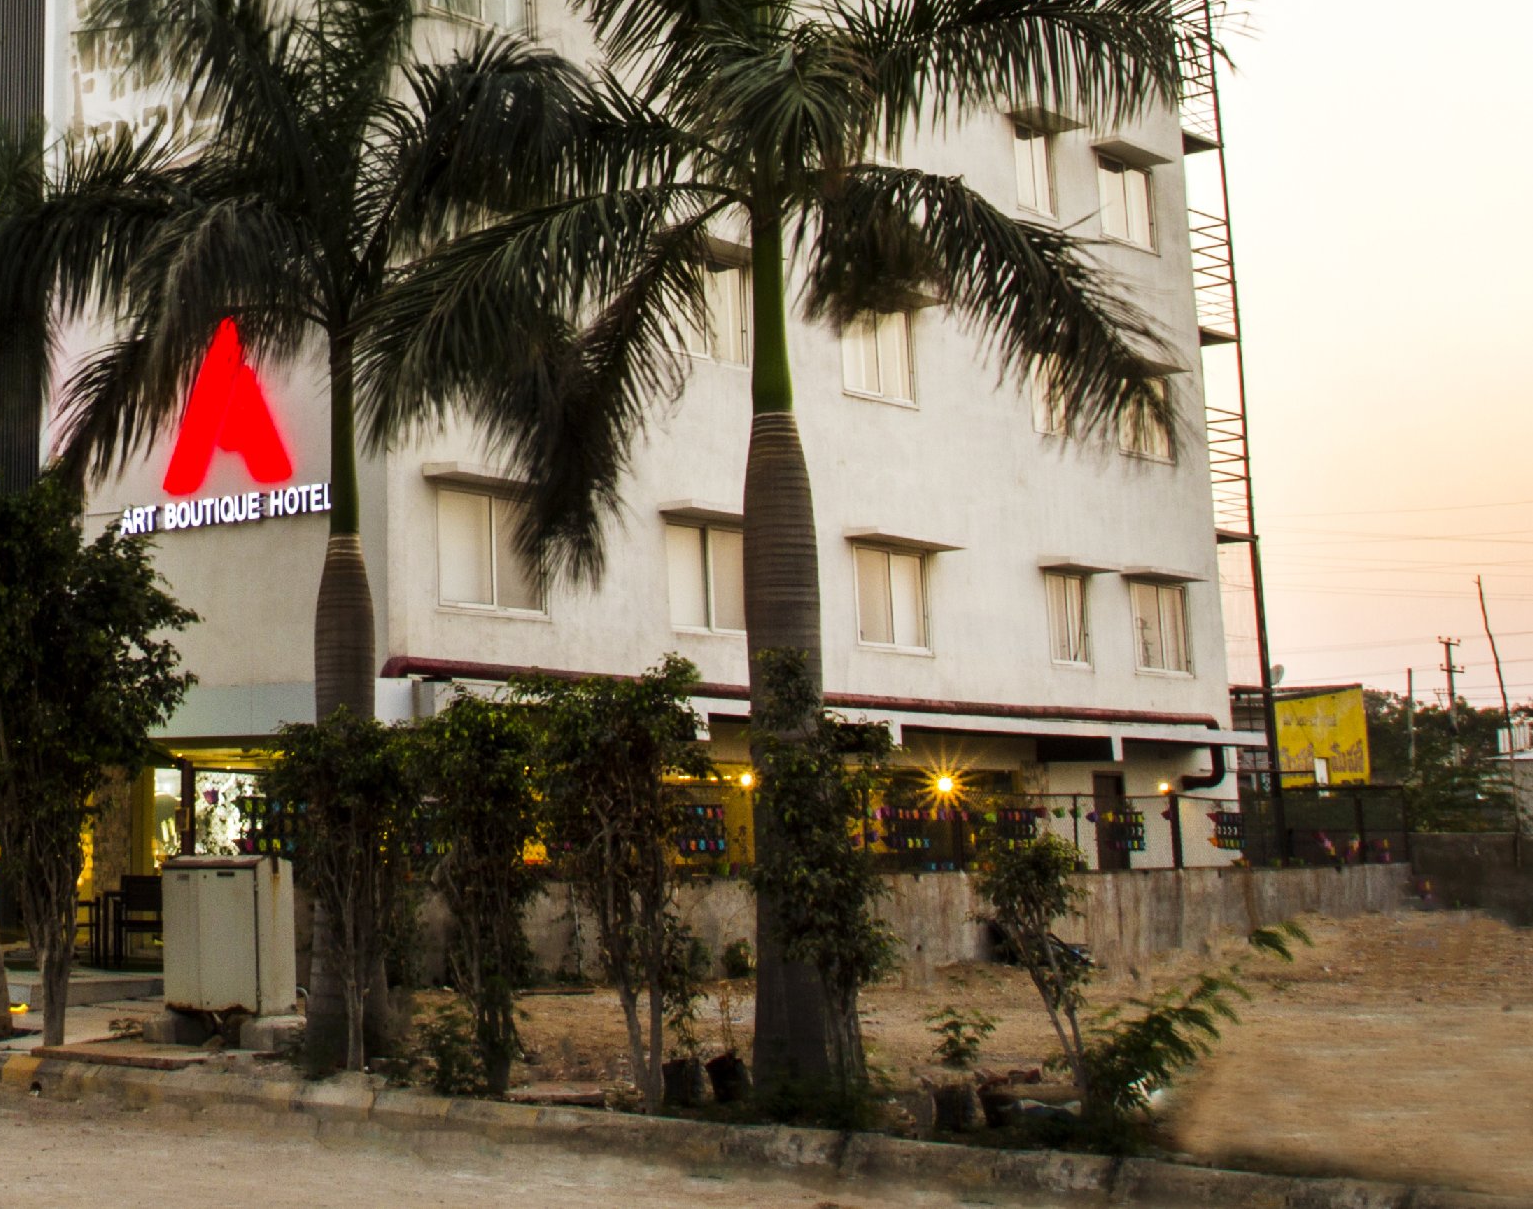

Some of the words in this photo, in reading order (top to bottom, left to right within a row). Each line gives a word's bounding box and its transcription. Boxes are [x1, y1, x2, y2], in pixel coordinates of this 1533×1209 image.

[120, 505, 157, 535] ART
[164, 492, 260, 530] BOUTIQUE
[269, 483, 331, 517] HOTEL
